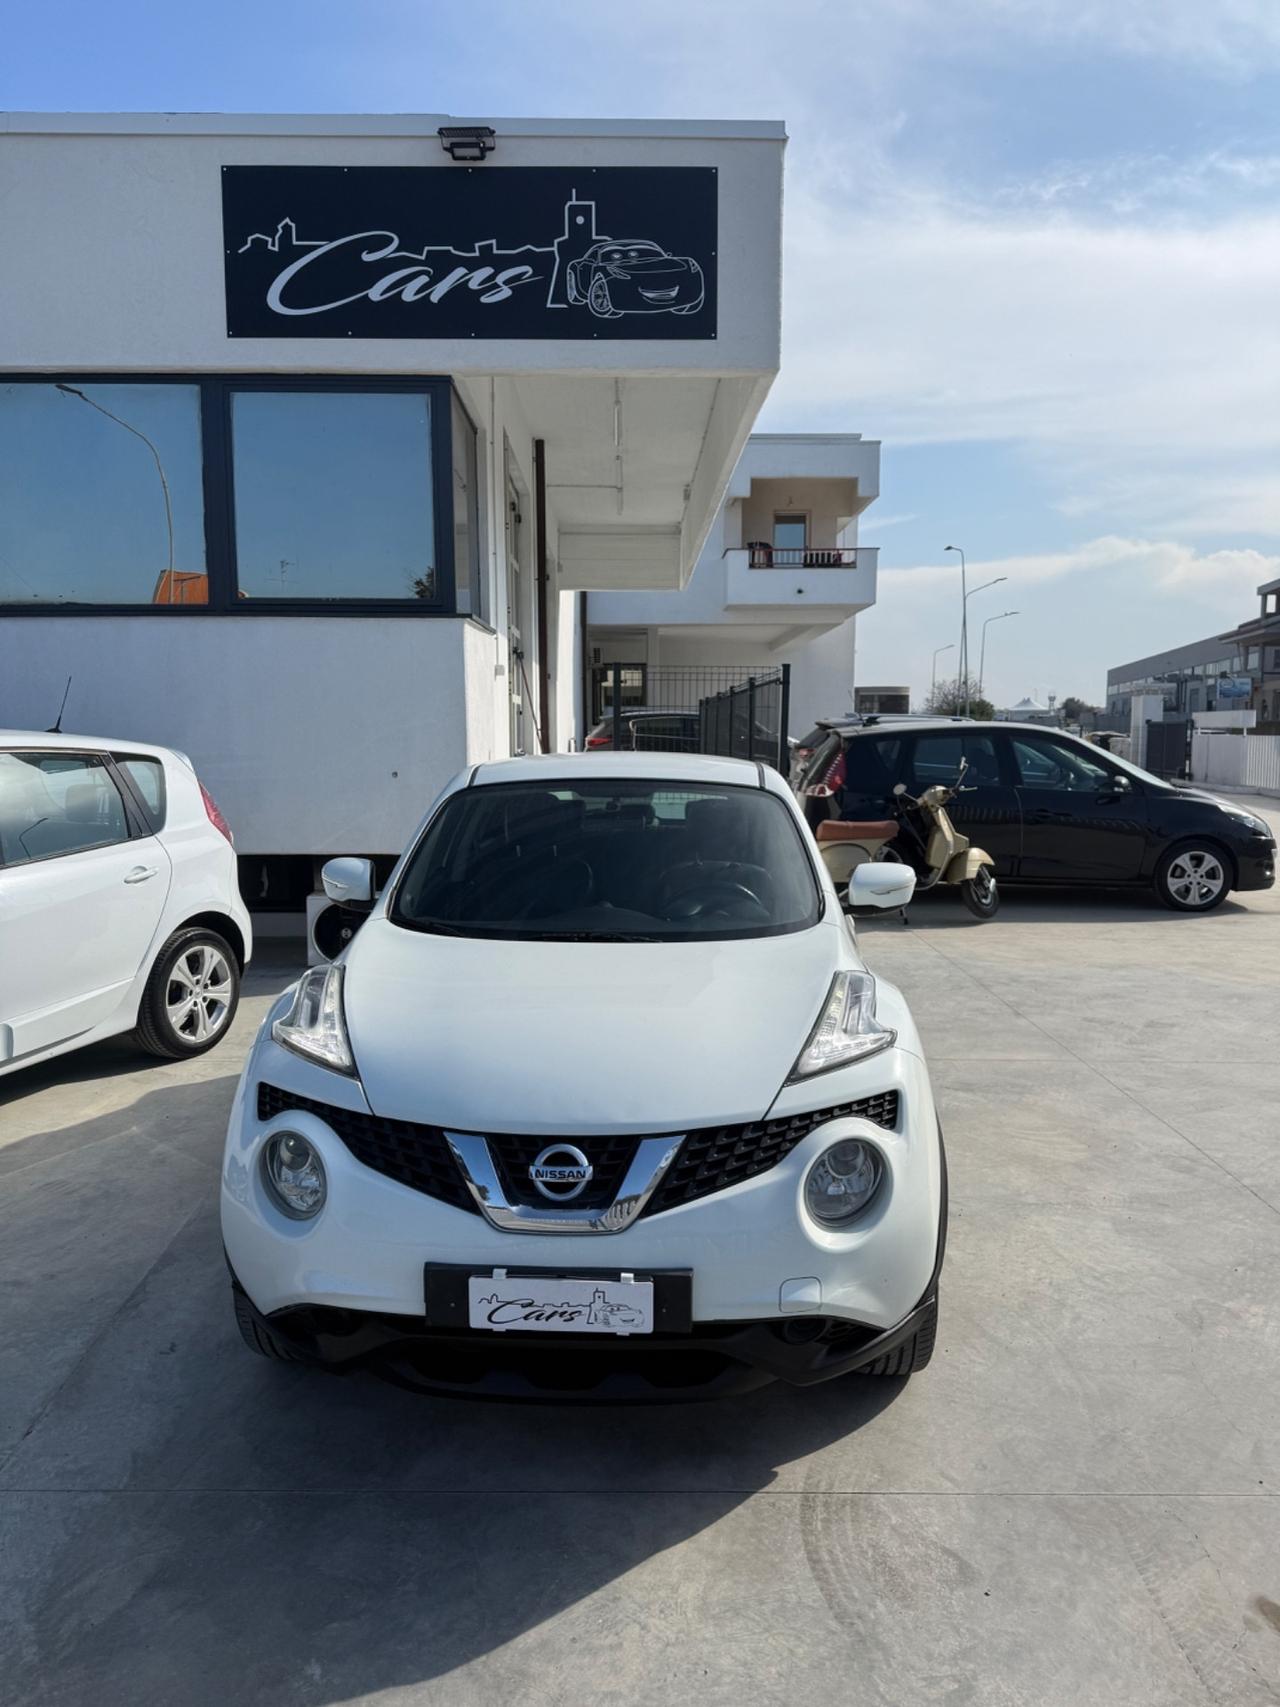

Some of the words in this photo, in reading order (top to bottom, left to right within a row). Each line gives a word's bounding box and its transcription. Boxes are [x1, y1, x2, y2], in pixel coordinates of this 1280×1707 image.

[267, 231, 543, 315] Cars
[534, 1169, 586, 1179] NISSAN
[488, 1299, 584, 1324] Cars
